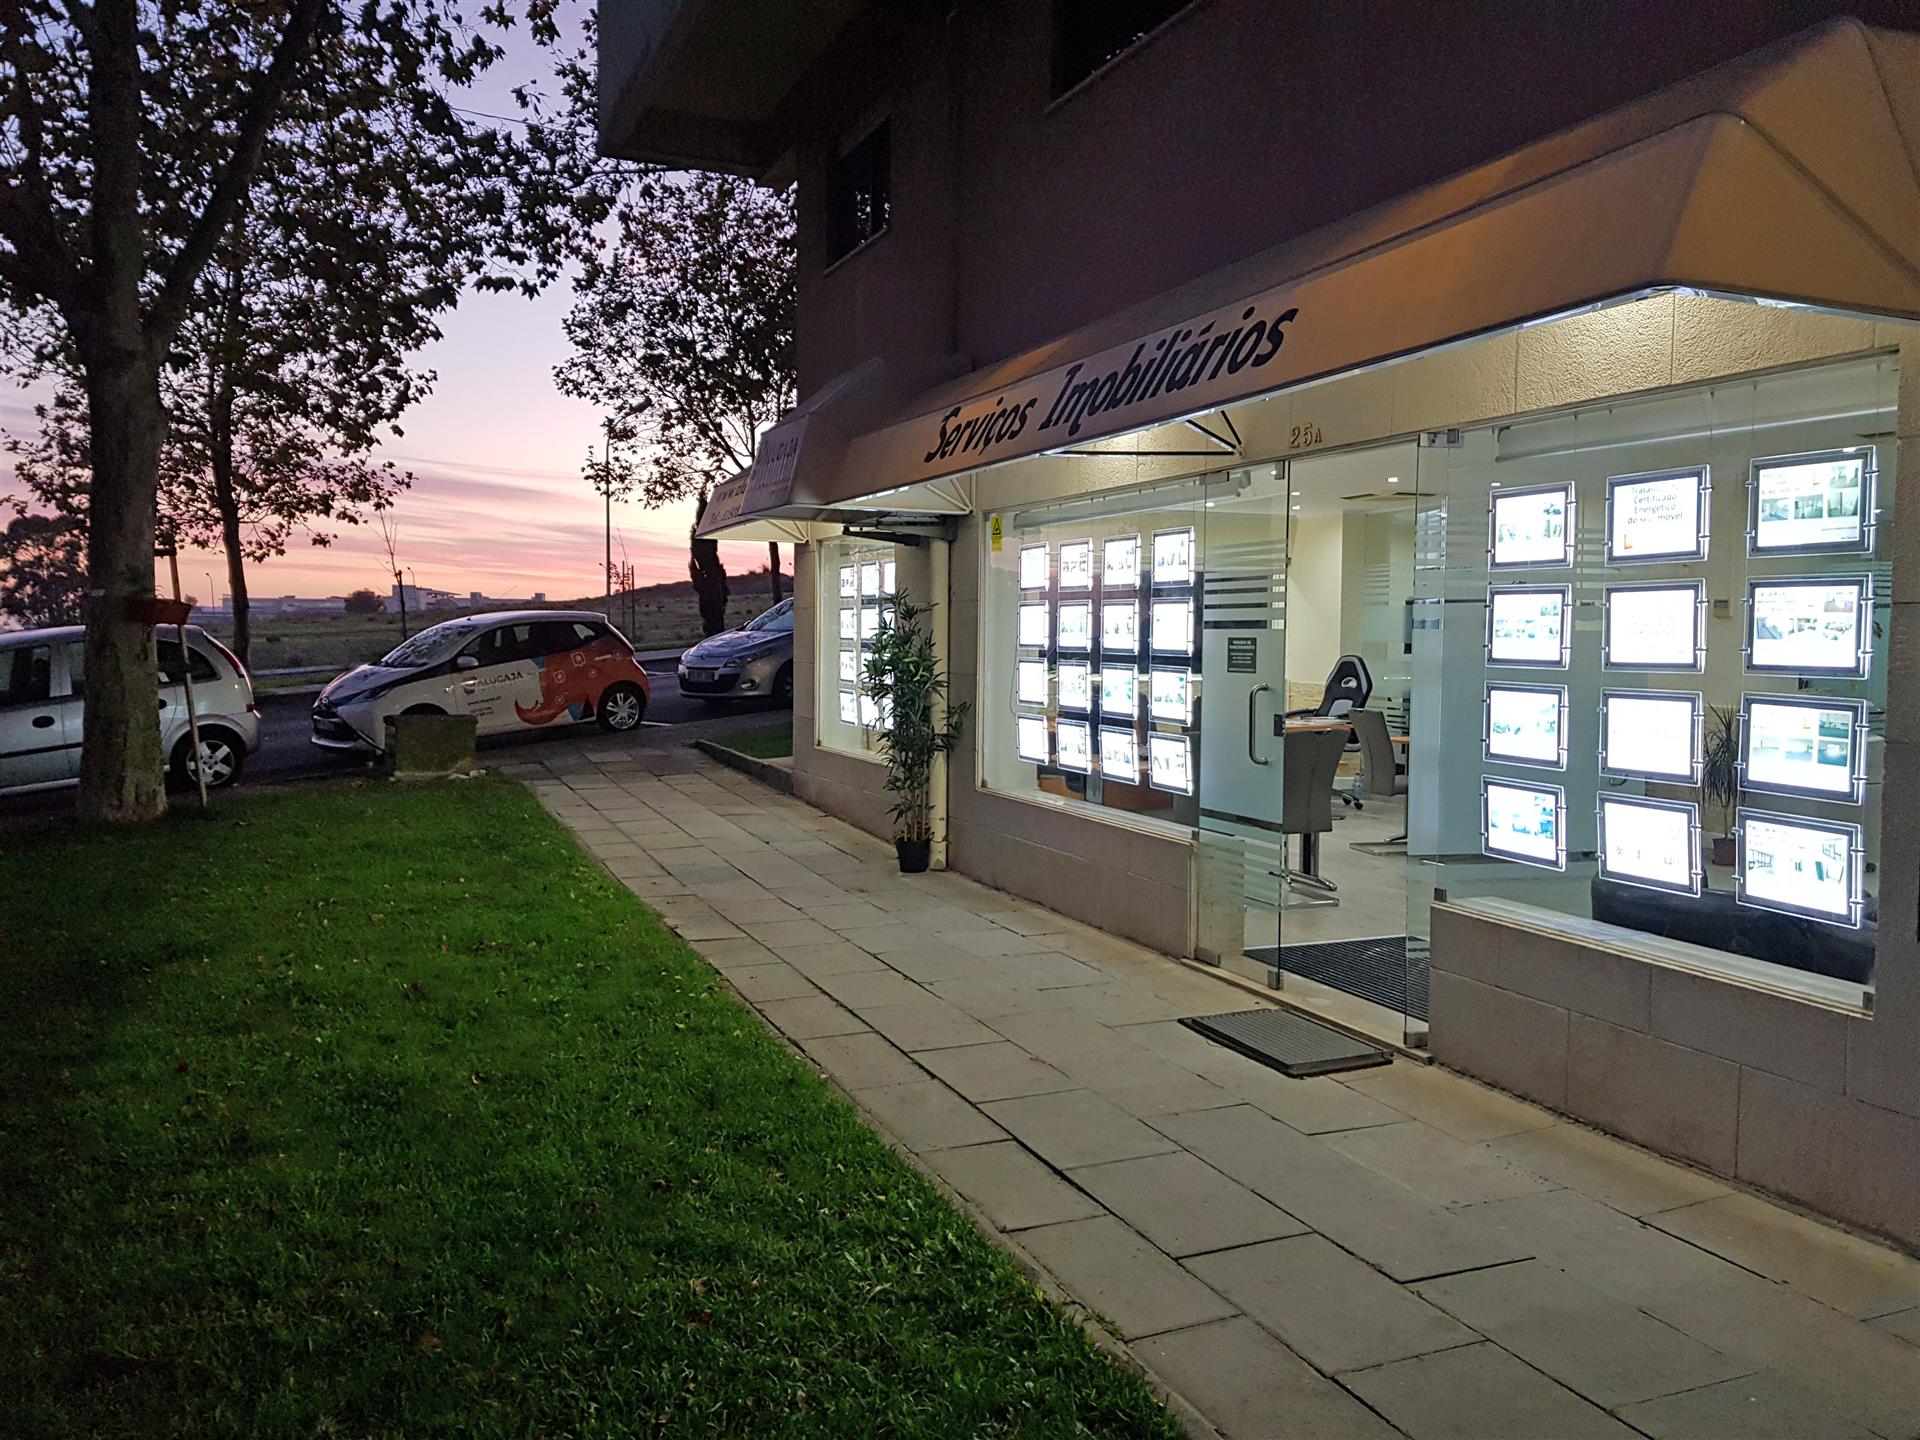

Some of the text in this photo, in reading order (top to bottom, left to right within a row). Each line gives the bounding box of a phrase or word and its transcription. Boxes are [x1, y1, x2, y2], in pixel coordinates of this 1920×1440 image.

[924, 306, 1299, 463] Serviços Imobiliários
[1290, 422, 1322, 448] 25A
